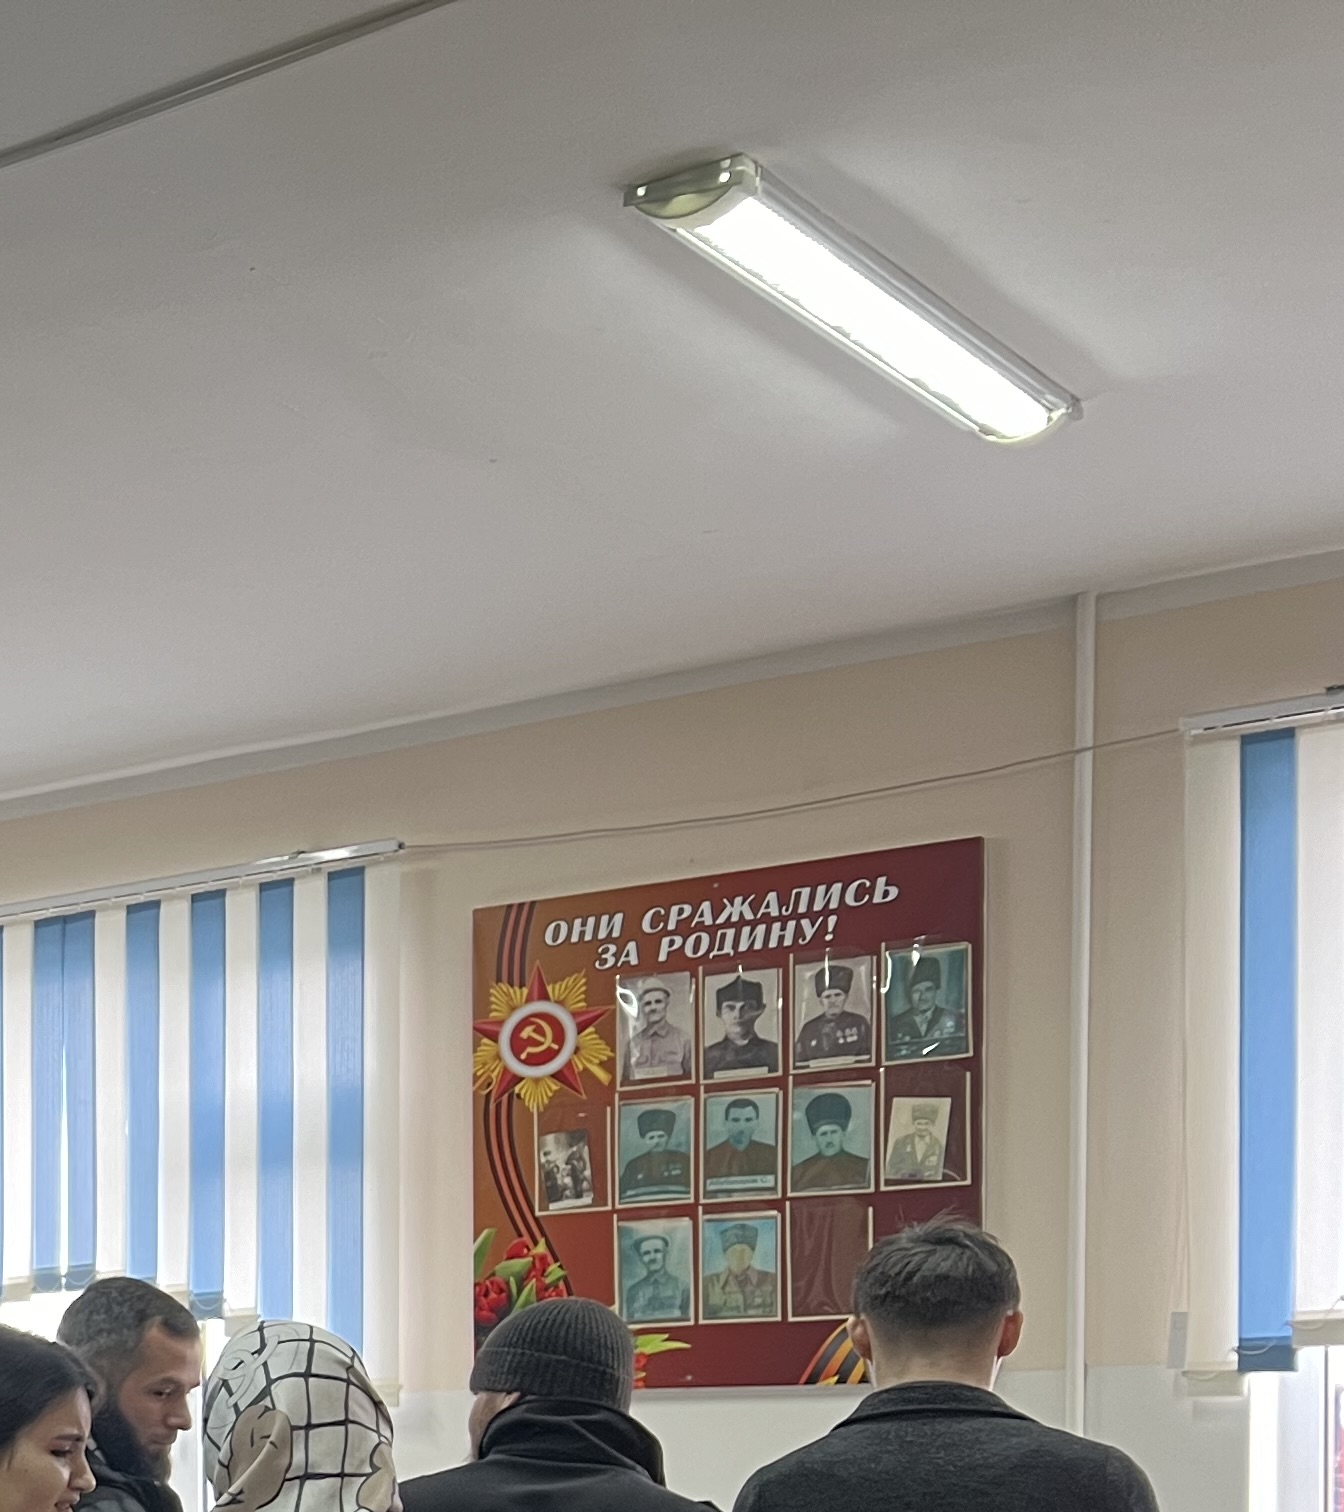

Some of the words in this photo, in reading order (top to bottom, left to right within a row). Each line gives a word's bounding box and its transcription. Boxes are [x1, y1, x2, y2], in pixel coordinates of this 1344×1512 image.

[543, 911, 625, 947] ОНИ
[641, 875, 900, 934] СРАЖАЛИСЬ
[594, 940, 640, 970] ЗА
[657, 914, 839, 962] РОДИНУ!
